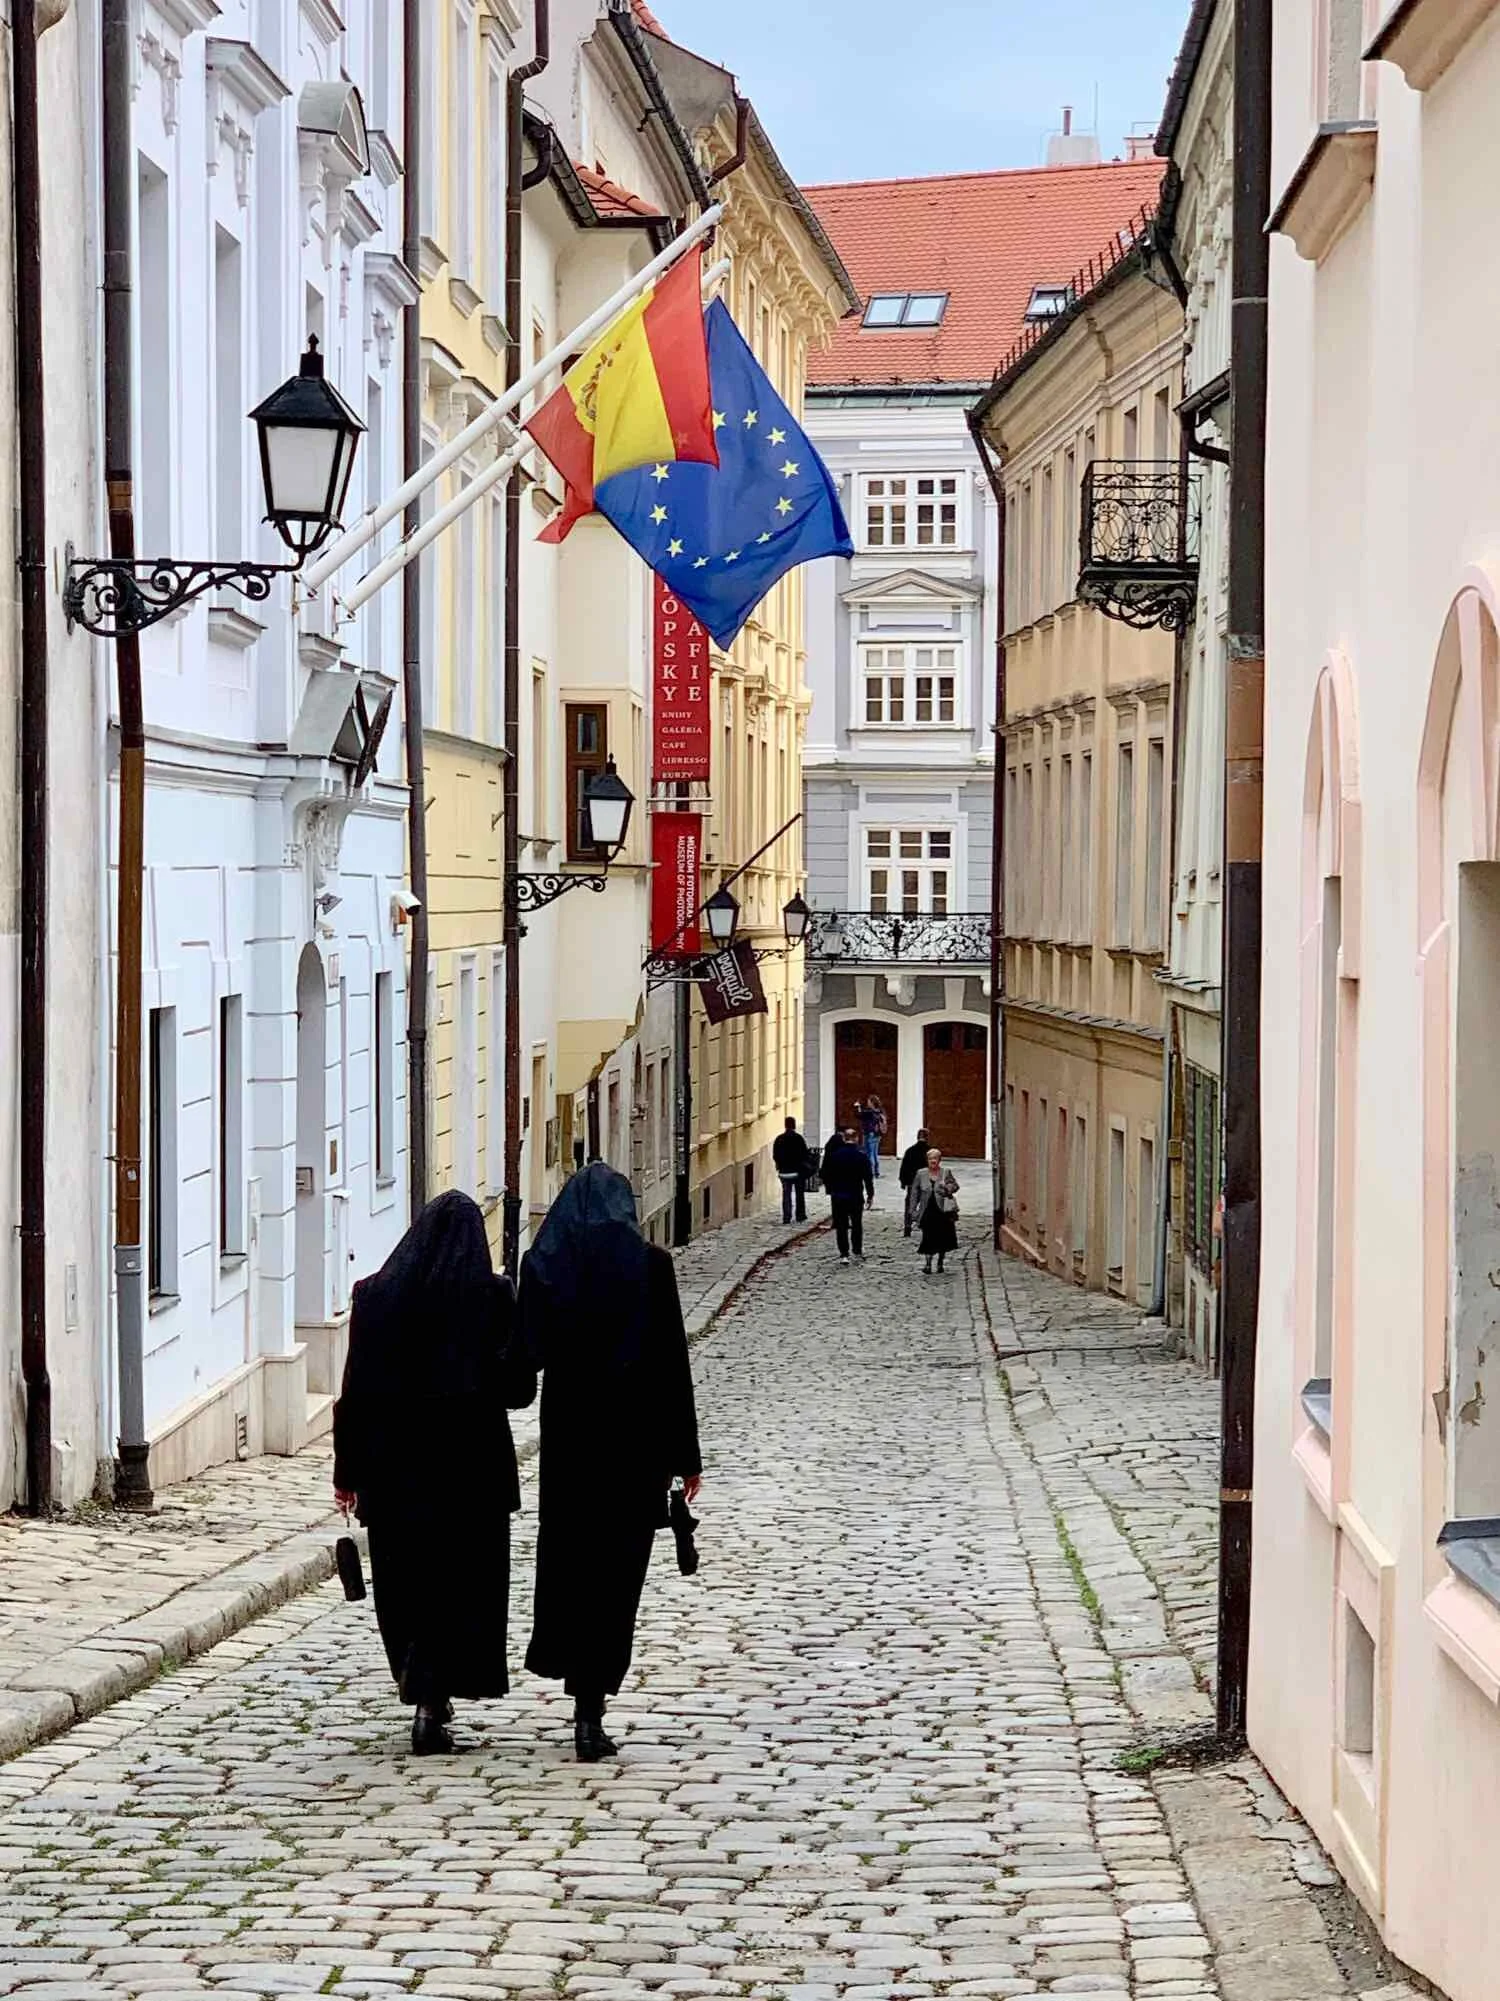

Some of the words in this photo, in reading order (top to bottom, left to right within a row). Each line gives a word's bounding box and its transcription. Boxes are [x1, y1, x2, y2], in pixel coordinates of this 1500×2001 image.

[687, 611, 703, 702] AFIE
[677, 835, 686, 874] MUSEUM
[677, 874, 686, 885] OF
